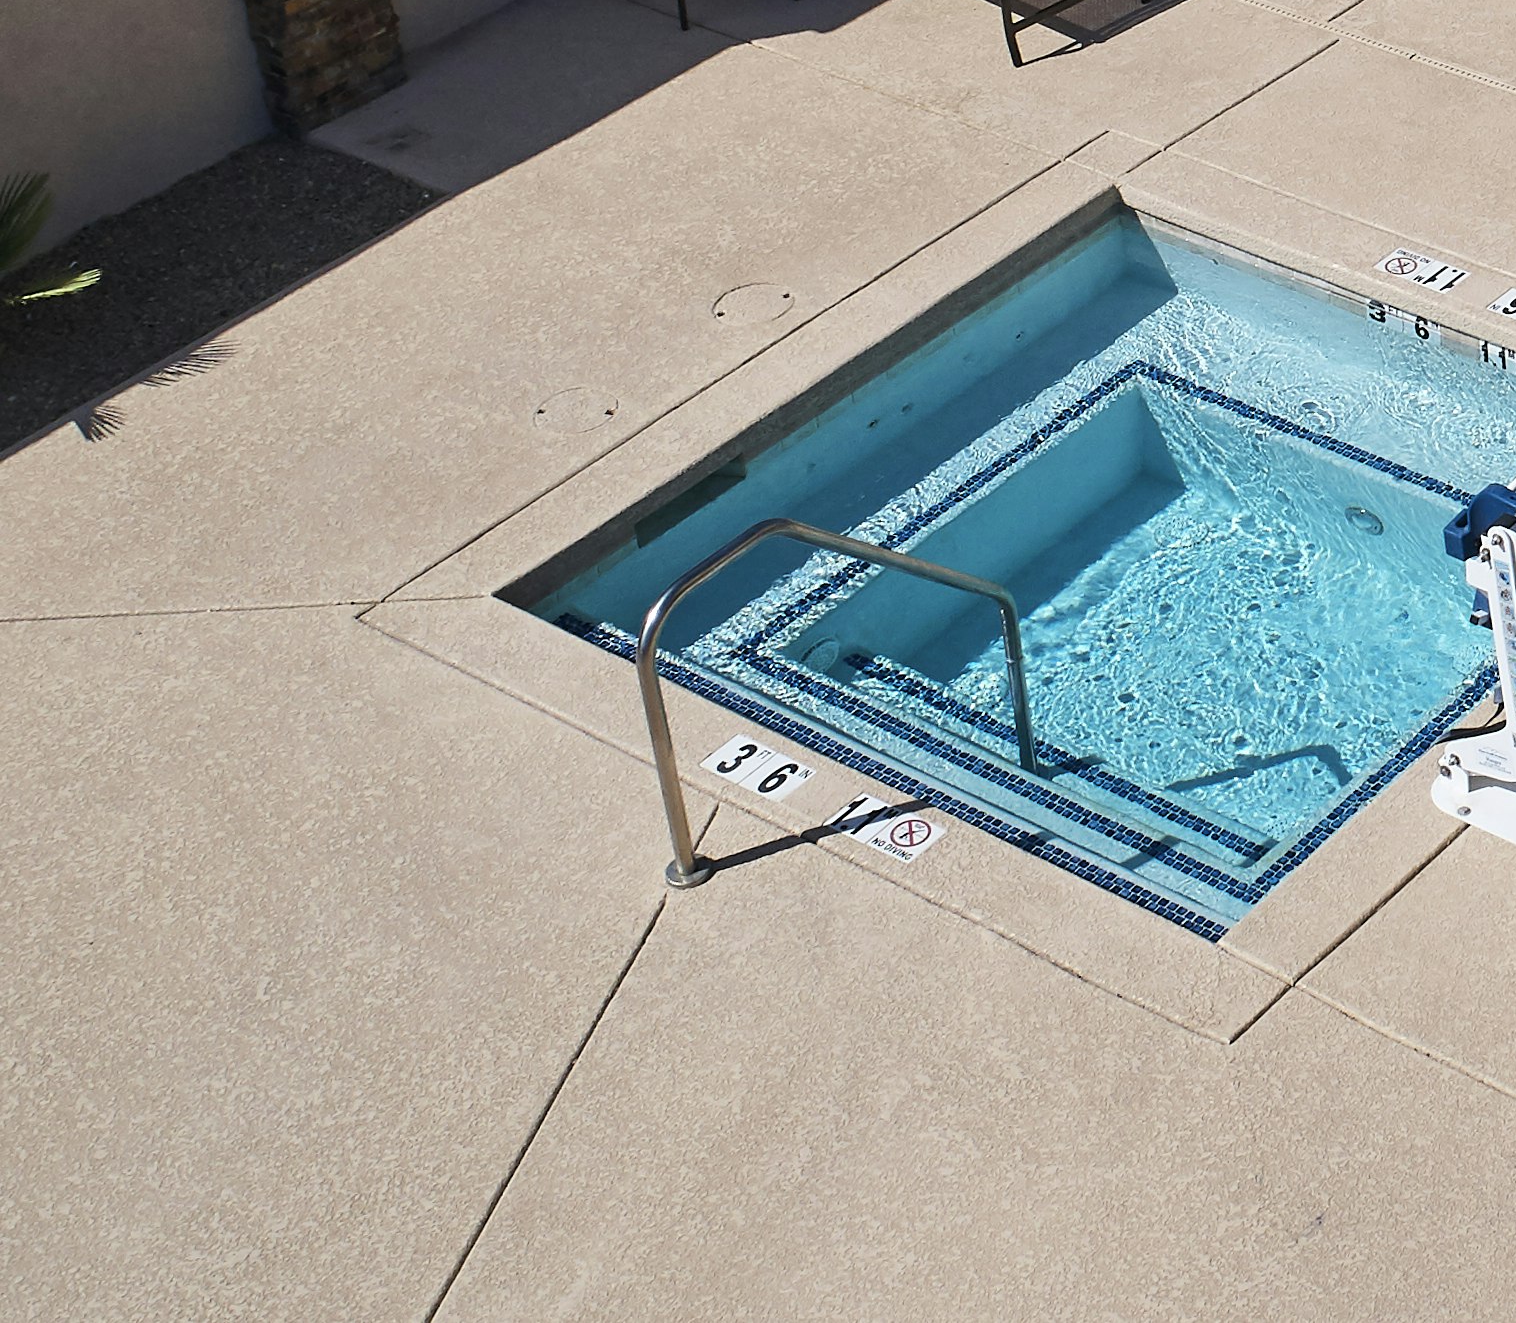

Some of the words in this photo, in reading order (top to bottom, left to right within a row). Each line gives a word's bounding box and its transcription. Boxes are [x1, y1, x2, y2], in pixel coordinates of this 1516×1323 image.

[1396, 249, 1420, 261] DIVING
[1422, 266, 1466, 291] 1.1
[1369, 300, 1387, 323] 3
[1415, 315, 1430, 340] 6
[717, 744, 758, 774] 3
[757, 749, 770, 759] FT
[757, 763, 800, 793] 6
[799, 769, 811, 779] IN
[871, 837, 887, 850] NO
[886, 843, 913, 861] DIVING
